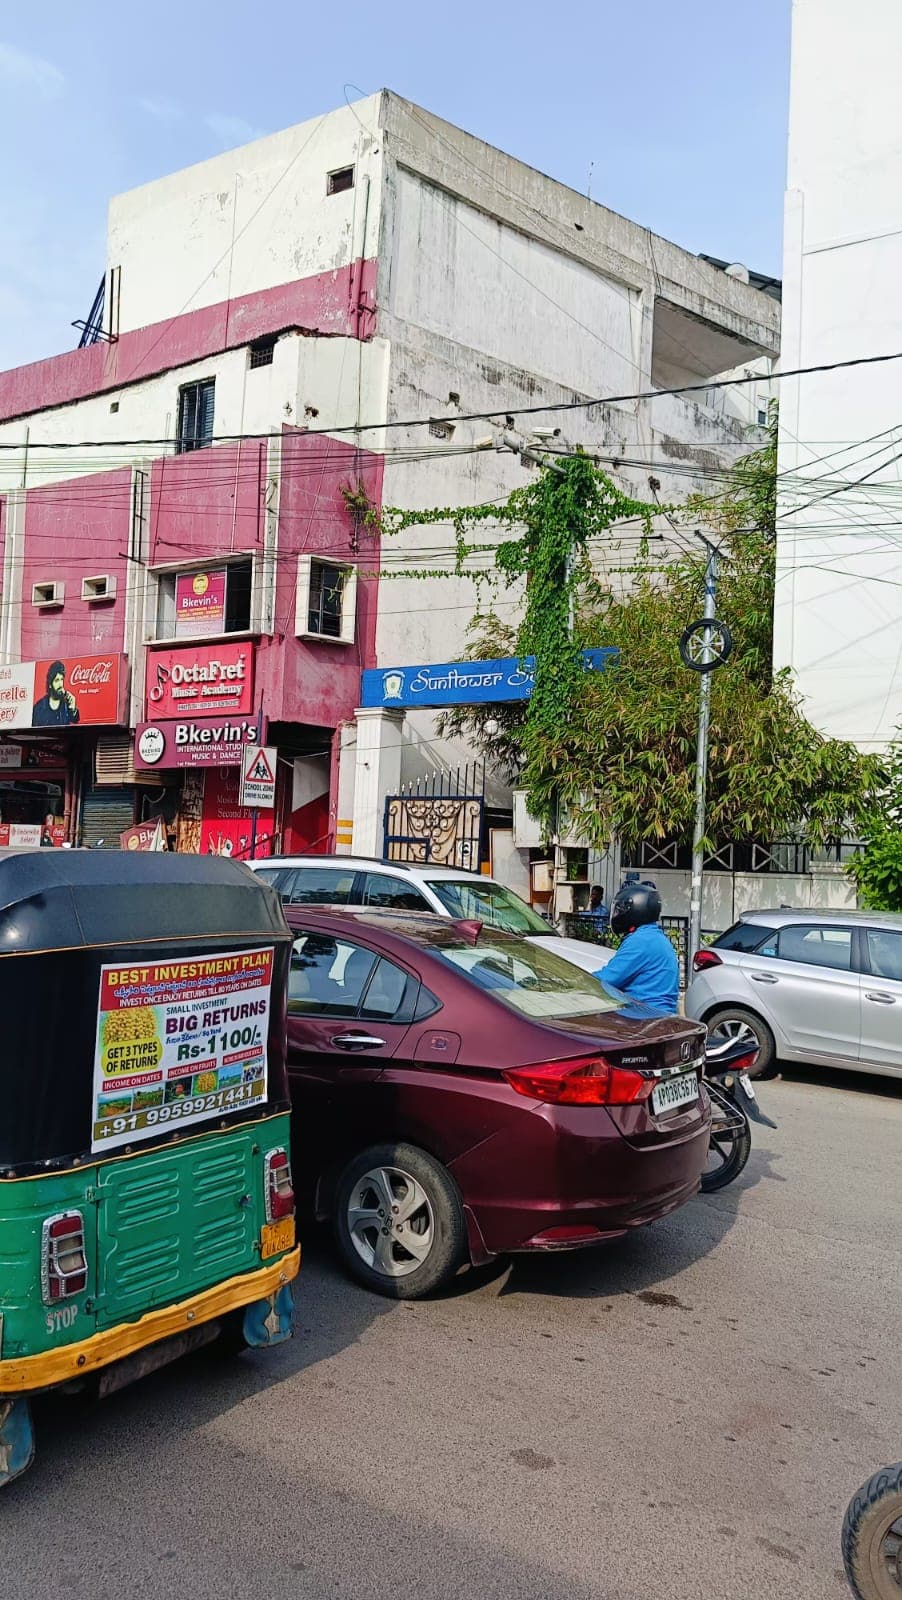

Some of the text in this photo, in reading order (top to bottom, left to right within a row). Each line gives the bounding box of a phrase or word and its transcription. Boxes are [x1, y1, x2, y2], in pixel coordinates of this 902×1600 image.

[182, 595, 218, 608] Bkevin's
[171, 659, 246, 684] OctaFret
[410, 669, 503, 692] Sunflower
[171, 683, 245, 698] Music Academy
[175, 722, 257, 744] Bkevin's
[177, 743, 224, 753] INTERNATIONAL
[191, 752, 210, 760] MUSIC
[220, 751, 241, 759] DANCE
[217, 807, 261, 818] Second Flr
[108, 969, 149, 986] BEST
[154, 957, 239, 981] INVESTMENT
[242, 953, 270, 968] PLAN
[120, 996, 143, 1007] INVEST
[143, 994, 162, 1004] ONCE
[162, 992, 181, 1002] ENJOY
[182, 988, 208, 999] RETURNS
[225, 983, 240, 992] YEARS
[166, 997, 228, 1015] SMALL INVESTMENT
[165, 1000, 266, 1034] BIG RETURNS
[107, 1041, 158, 1059] GET 3 TYPES
[106, 1054, 158, 1072] OF RETURNS
[168, 1060, 216, 1077] INCOME ON FRUITS
[104, 1073, 161, 1088] INCOME ON DATES
[100, 1084, 252, 1137] +91 9959921441
[45, 1304, 78, 1335] STOP
